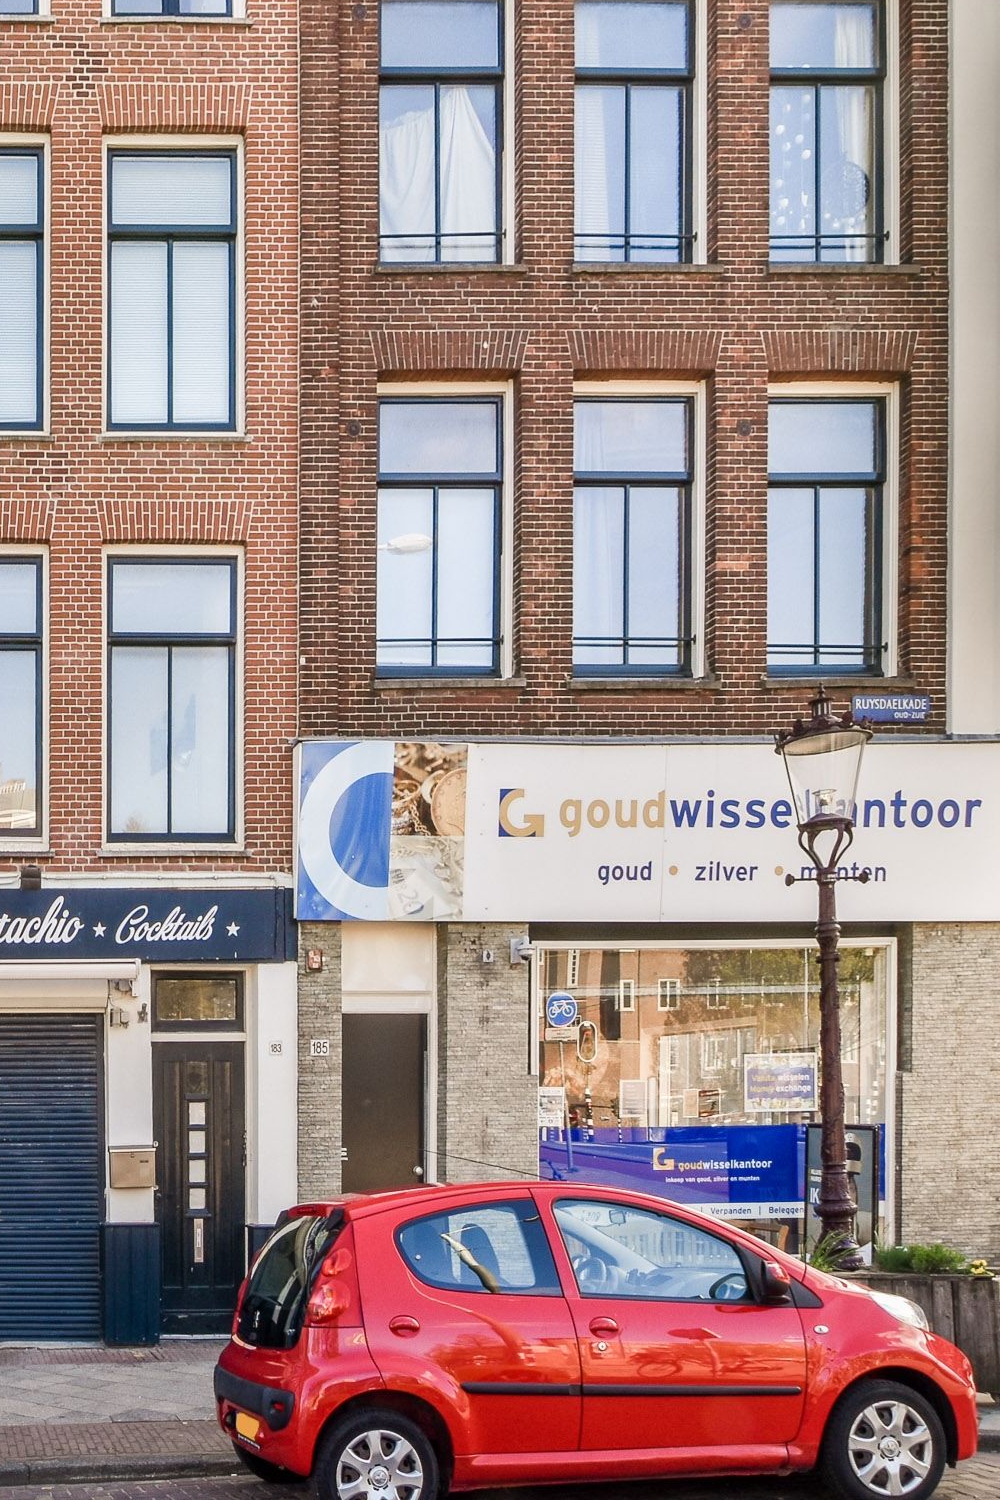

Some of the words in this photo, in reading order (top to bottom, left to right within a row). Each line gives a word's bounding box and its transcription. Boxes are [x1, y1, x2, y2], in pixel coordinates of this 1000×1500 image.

[855, 698, 927, 710] RUYSDAELKADE
[597, 860, 653, 886] goud
[694, 860, 759, 882] zilver
[799, 861, 887, 882] mnten
[115, 905, 219, 945] Cocktails
[270, 1044, 282, 1053] 183
[312, 1041, 328, 1054] 185
[776, 1084, 812, 1093] exchange
[678, 1159, 772, 1172] goudwisselkantoor
[711, 1206, 752, 1215] Verpanden
